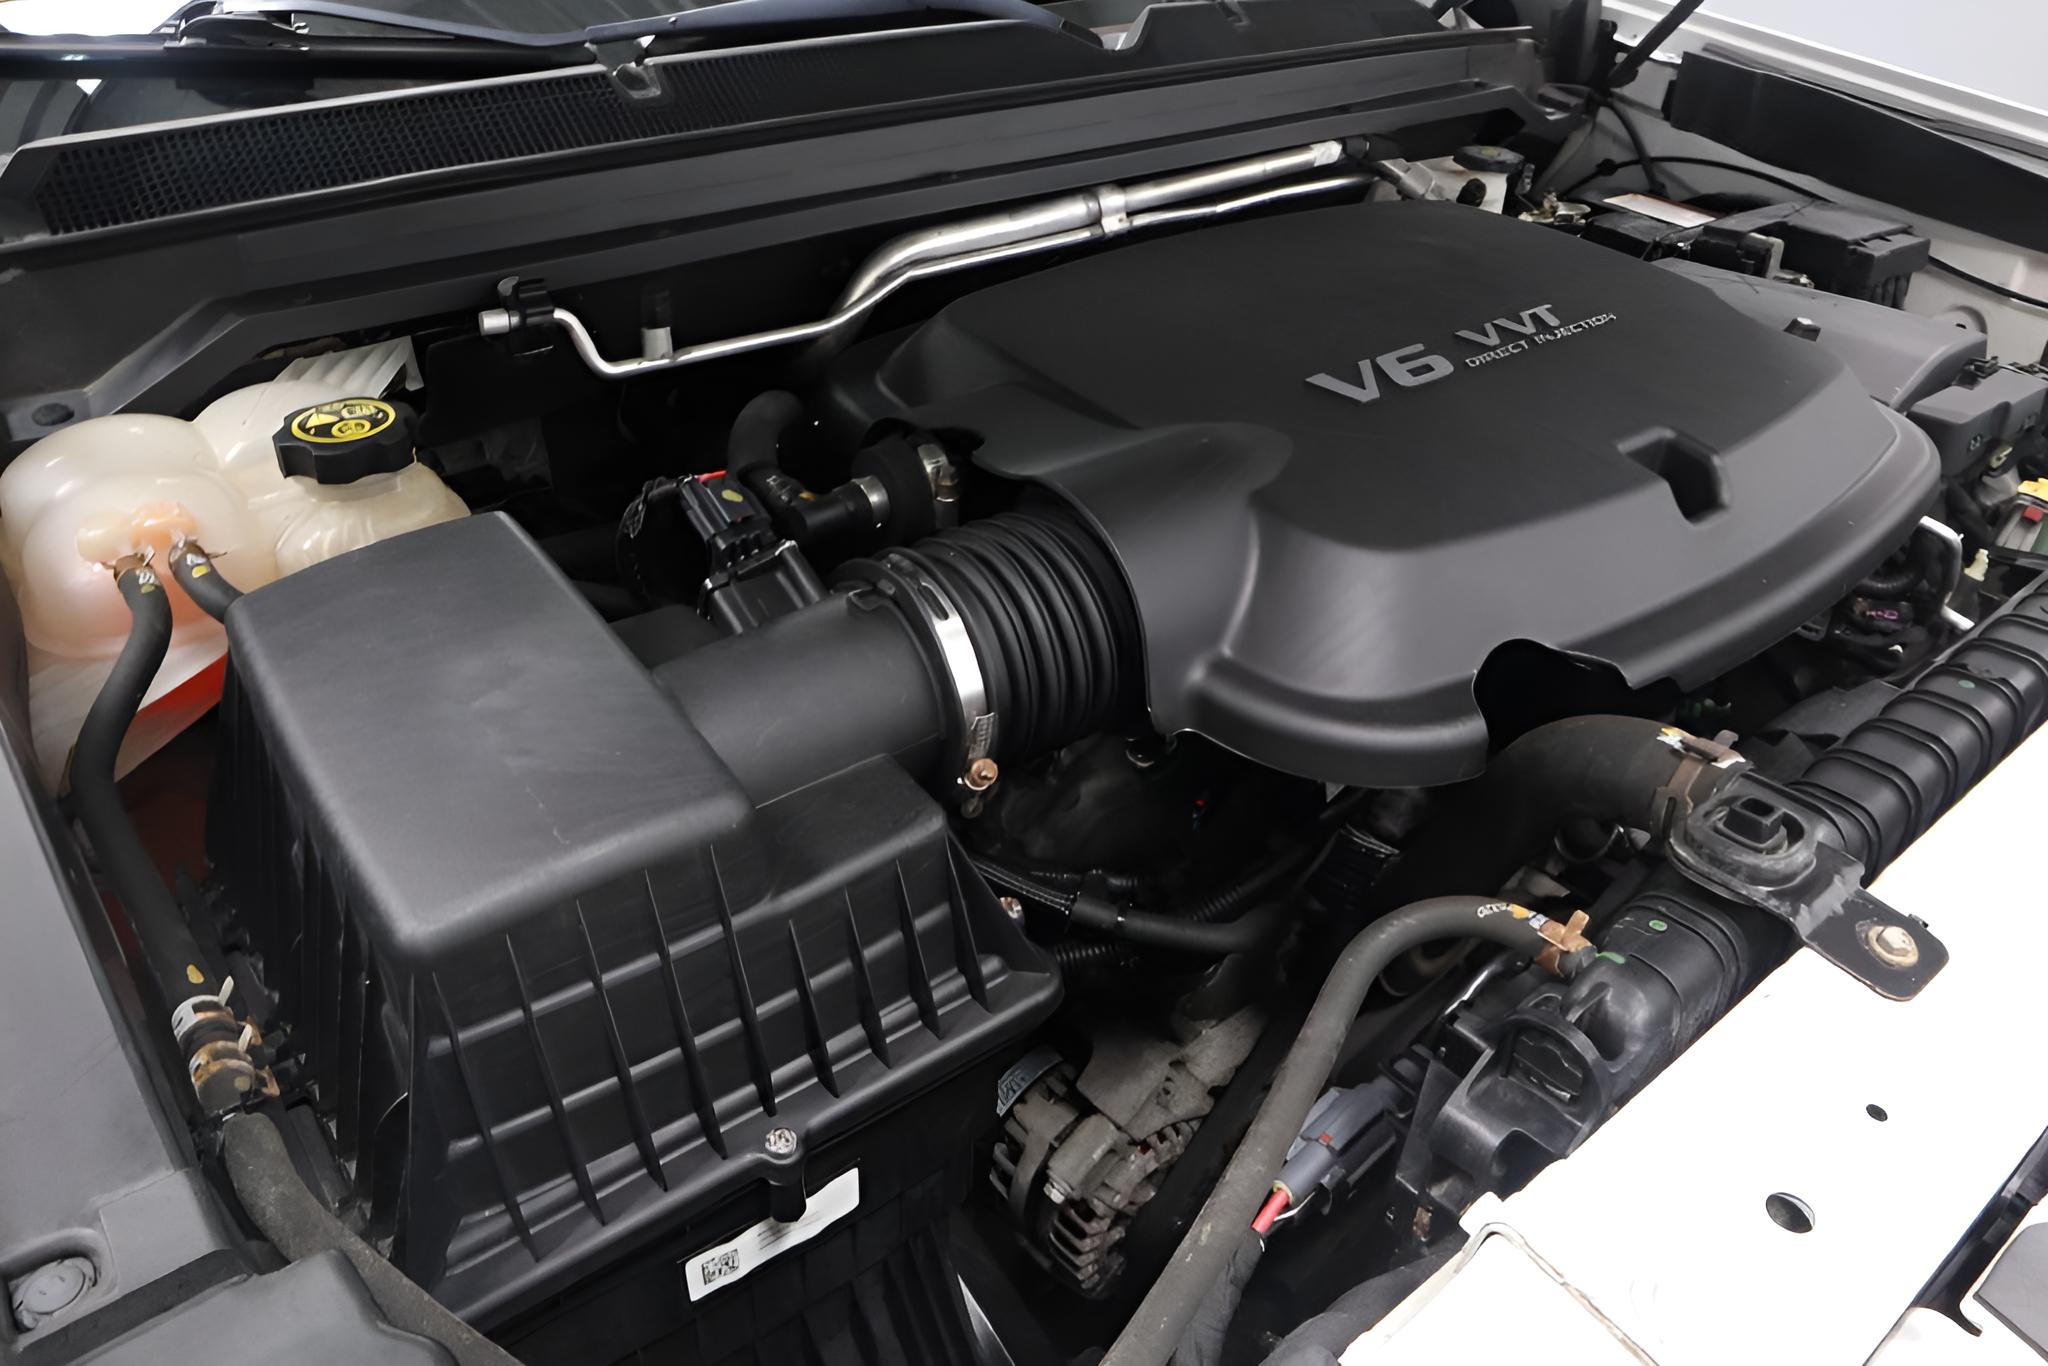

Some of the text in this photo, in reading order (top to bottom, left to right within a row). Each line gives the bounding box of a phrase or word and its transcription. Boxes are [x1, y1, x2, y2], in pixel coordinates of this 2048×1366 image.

[1305, 304, 1561, 403] V6 VVT
[1465, 313, 1617, 367] DIRECT INJECTION
